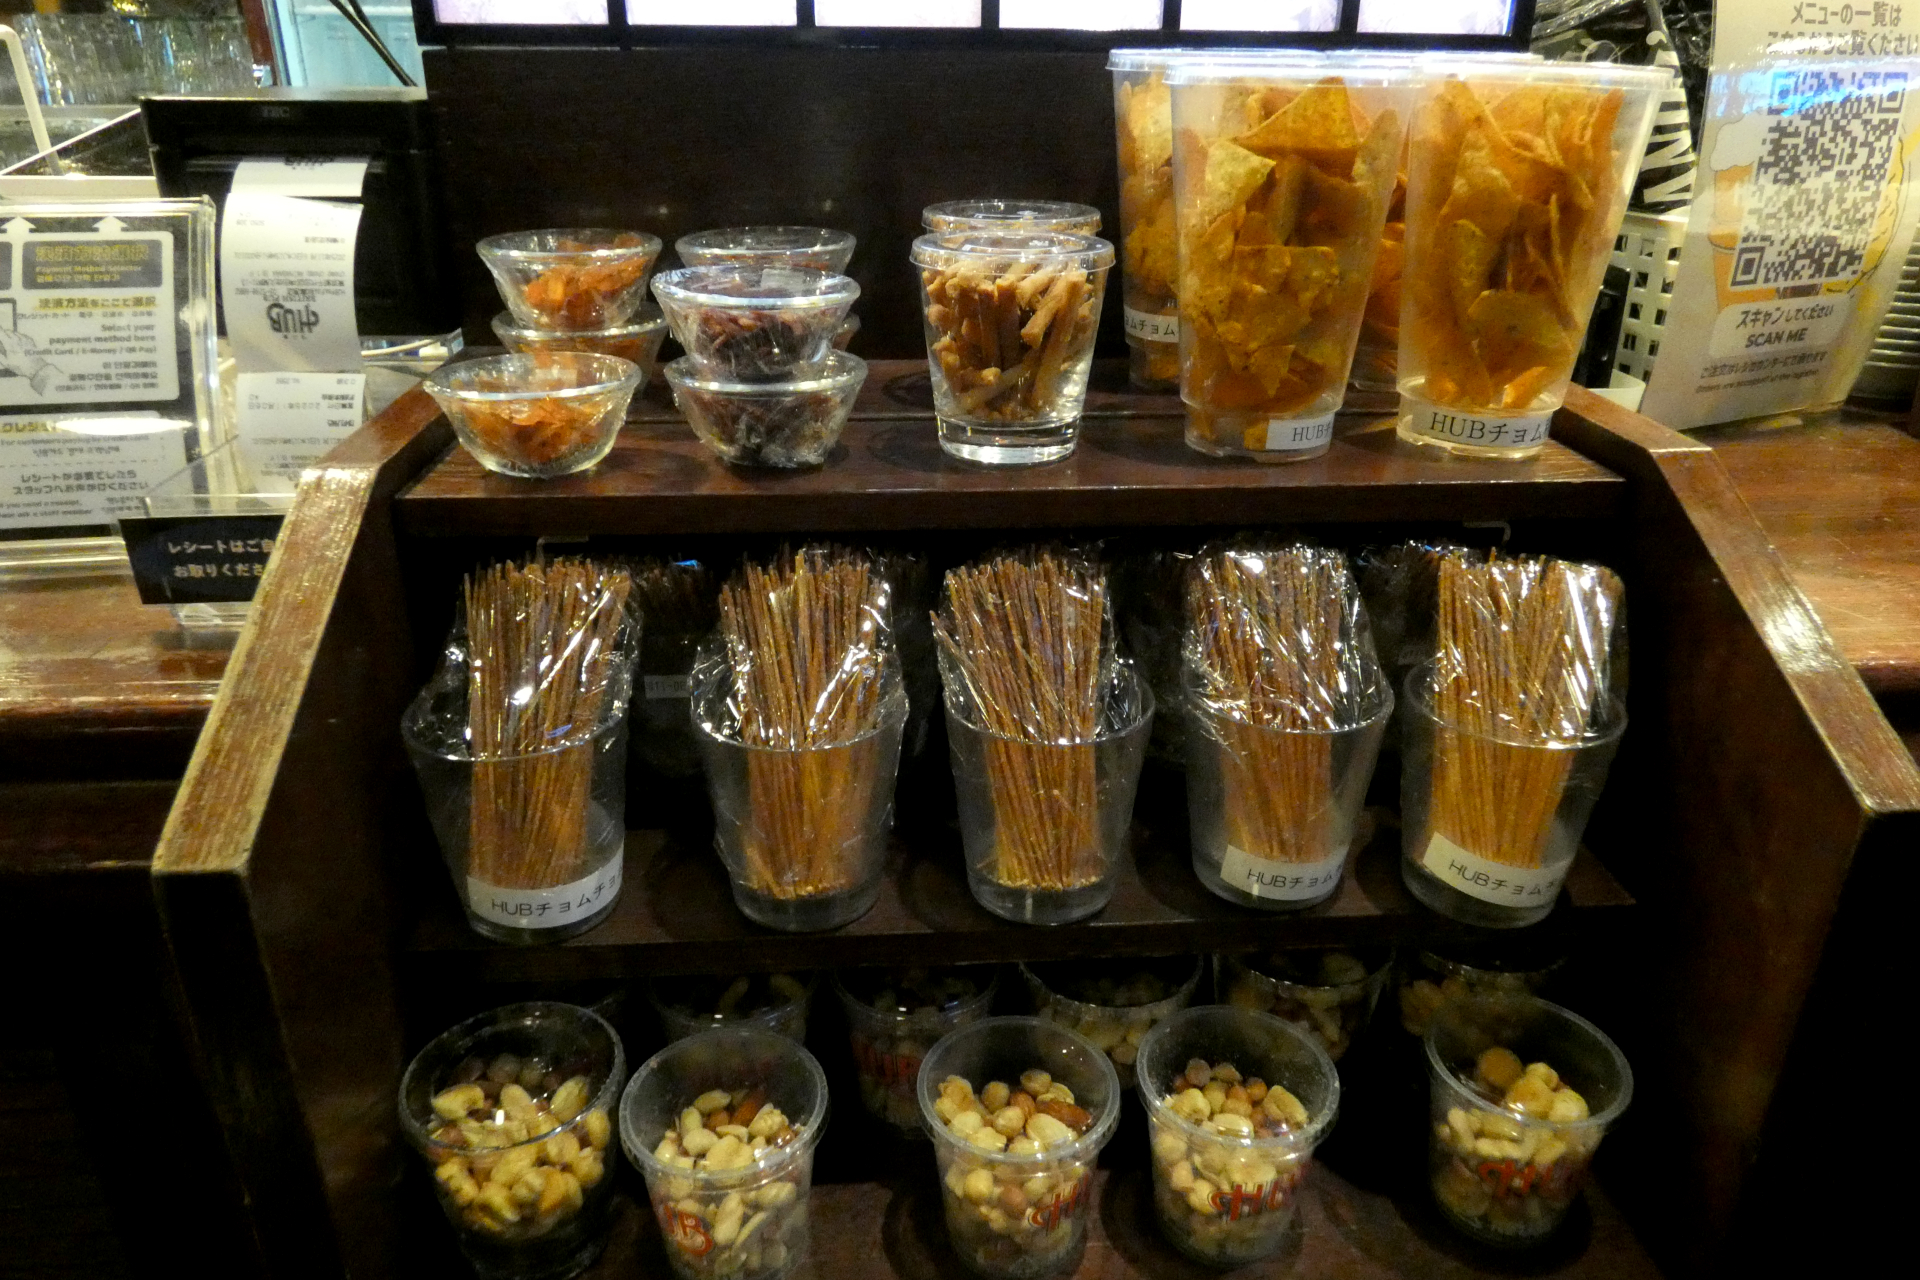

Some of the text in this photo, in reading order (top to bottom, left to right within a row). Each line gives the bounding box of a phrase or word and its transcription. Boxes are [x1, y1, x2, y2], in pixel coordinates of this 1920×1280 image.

[1790, 1, 1902, 27] メニューの一覧は
[266, 303, 319, 335] HUB
[1736, 304, 1834, 329] スキャンしてください
[94, 335, 132, 343] method
[1745, 327, 1809, 349] SCAN ME
[1431, 412, 1549, 444] HUBチョム
[491, 872, 620, 917] HUBチョムチョ
